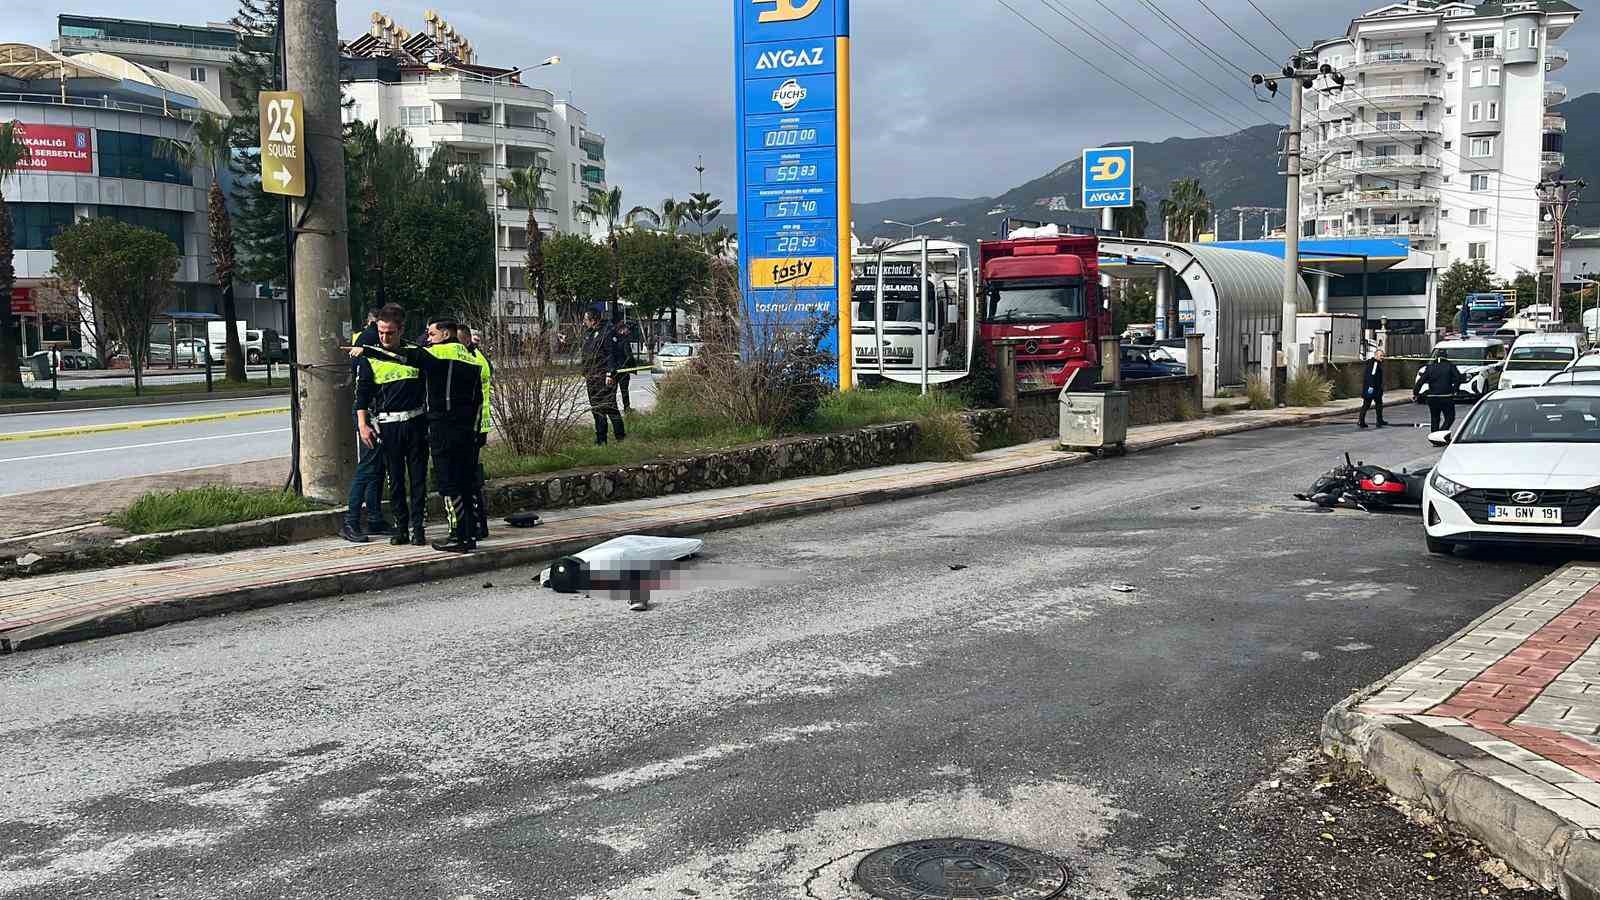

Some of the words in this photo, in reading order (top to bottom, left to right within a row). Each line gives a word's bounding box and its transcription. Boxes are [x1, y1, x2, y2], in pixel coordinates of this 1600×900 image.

[755, 47, 824, 70] AYGAZ
[773, 89, 805, 100] FUCHS
[267, 99, 297, 144] 23
[35, 149, 87, 159] SERBESTLİK
[267, 143, 297, 159] SQUARE
[1090, 191, 1126, 202] AYGAZ
[772, 260, 812, 284] fasty
[856, 284, 880, 292] HUZU
[1497, 507, 1509, 518] 34
[1515, 507, 1535, 519] GNV
[1542, 508, 1558, 519] 191
